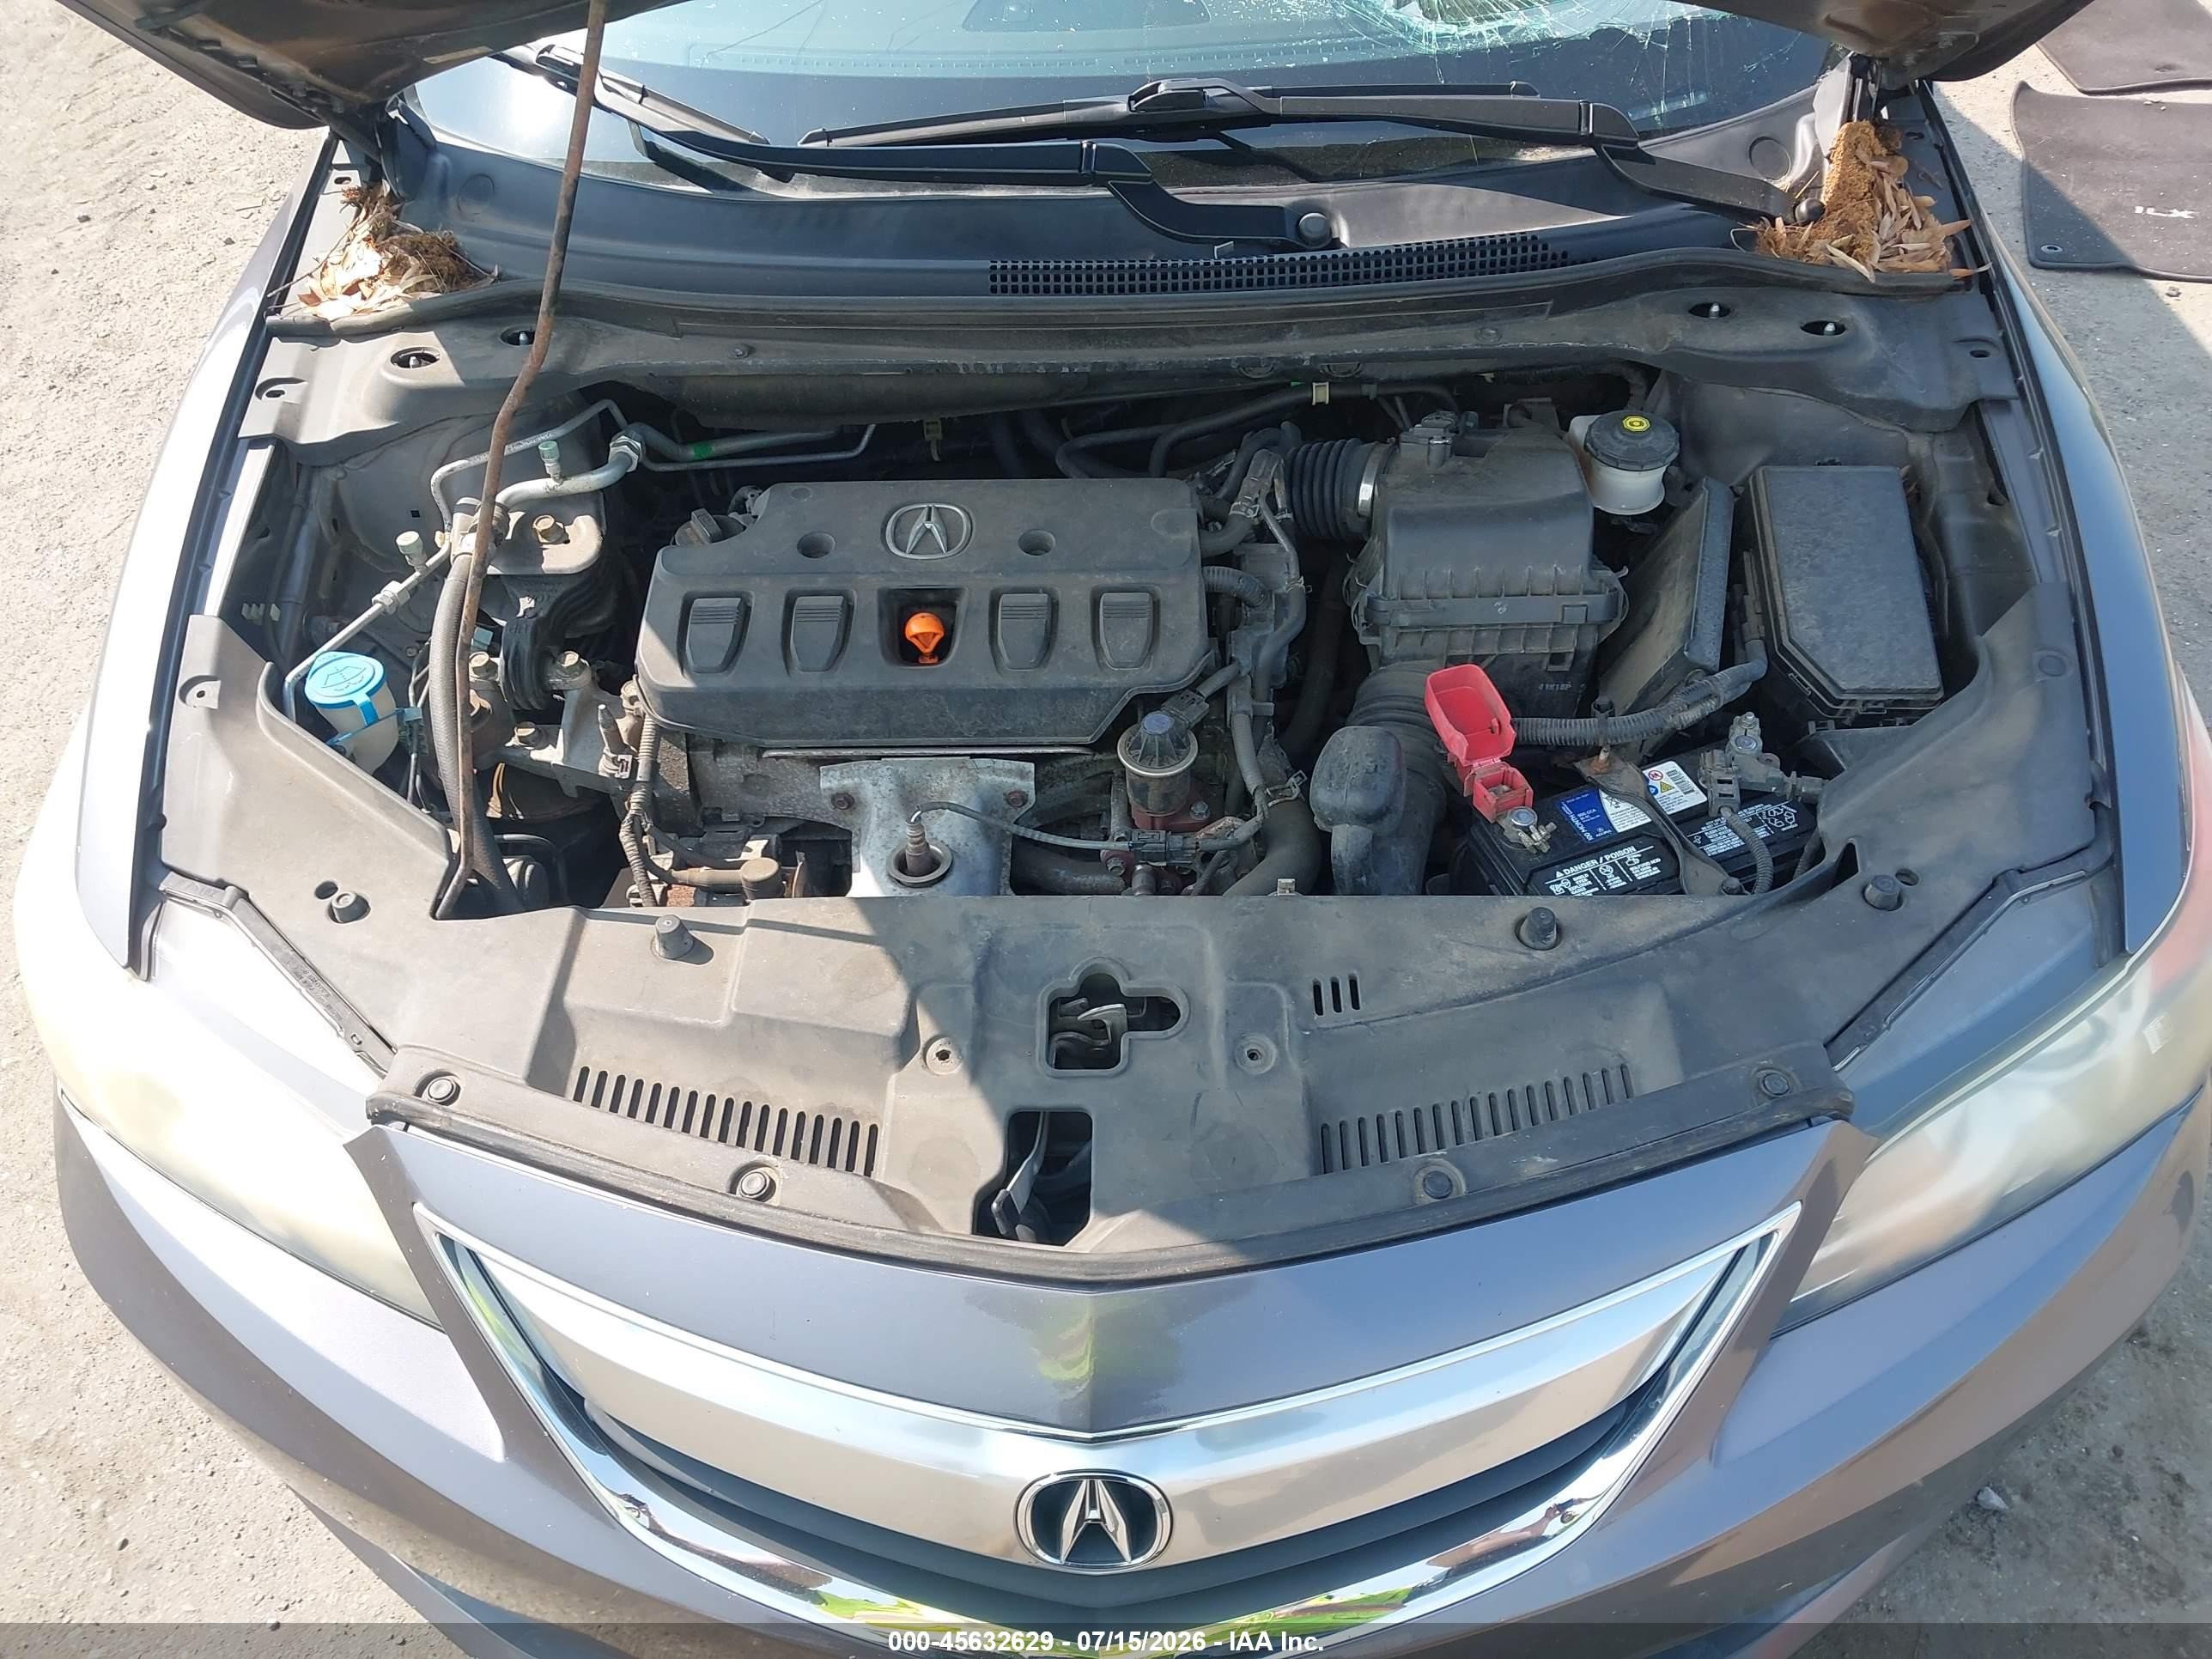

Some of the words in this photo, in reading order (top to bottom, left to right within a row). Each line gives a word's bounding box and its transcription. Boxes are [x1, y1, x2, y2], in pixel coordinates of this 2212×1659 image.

[1569, 813, 1588, 833] MONTH
[1563, 859, 1599, 875] DANGER
[1603, 846, 1637, 860] POISON
